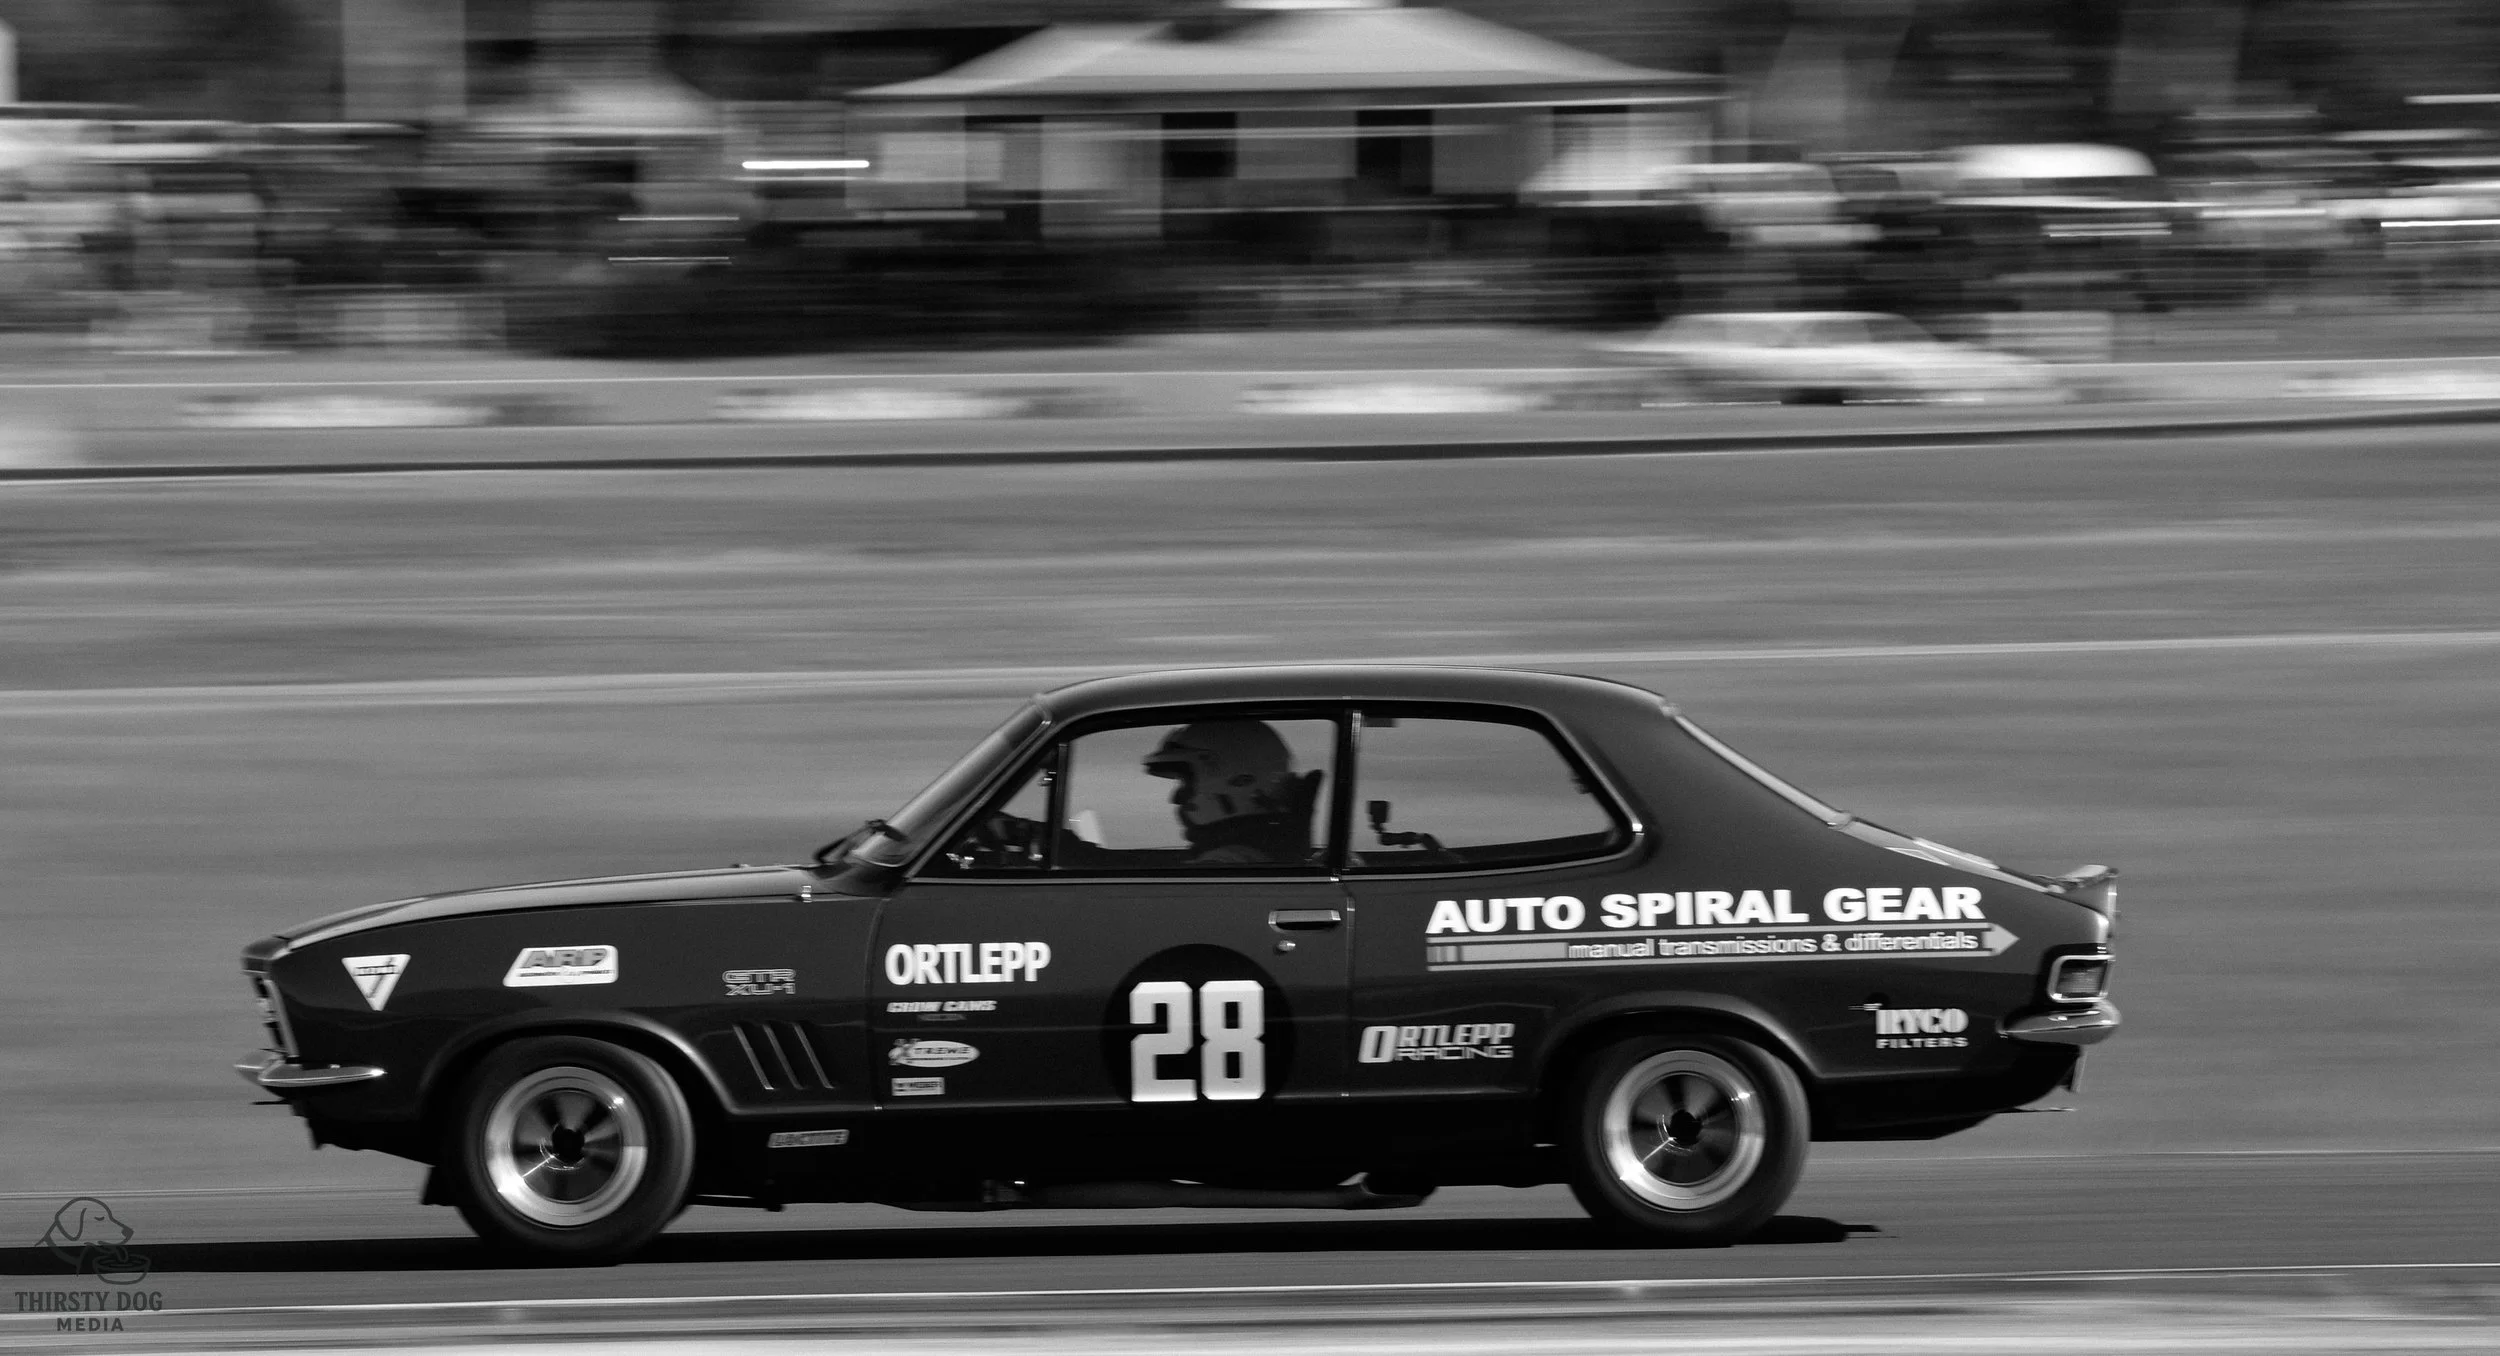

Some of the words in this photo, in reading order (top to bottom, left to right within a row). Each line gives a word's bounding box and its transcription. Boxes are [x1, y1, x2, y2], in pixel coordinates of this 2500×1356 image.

[1425, 895, 1586, 934] AUTO
[1600, 889, 1810, 928] SPIRAL
[1823, 886, 1986, 923] GEAR
[519, 948, 608, 969] ARP
[1568, 938, 1655, 959] manual
[1658, 934, 1818, 956] transmissions
[1820, 933, 1842, 952] &
[1844, 931, 1979, 951] differentials
[722, 968, 796, 984] GTR
[885, 942, 1051, 985] ORTLEPP
[1876, 1008, 1969, 1035] RYCO
[1130, 980, 1265, 1102] 28
[1358, 1023, 1515, 1063] ORTLEPP
[1394, 1045, 1514, 1061] RACING
[1876, 1037, 1969, 1049] FILTERS
